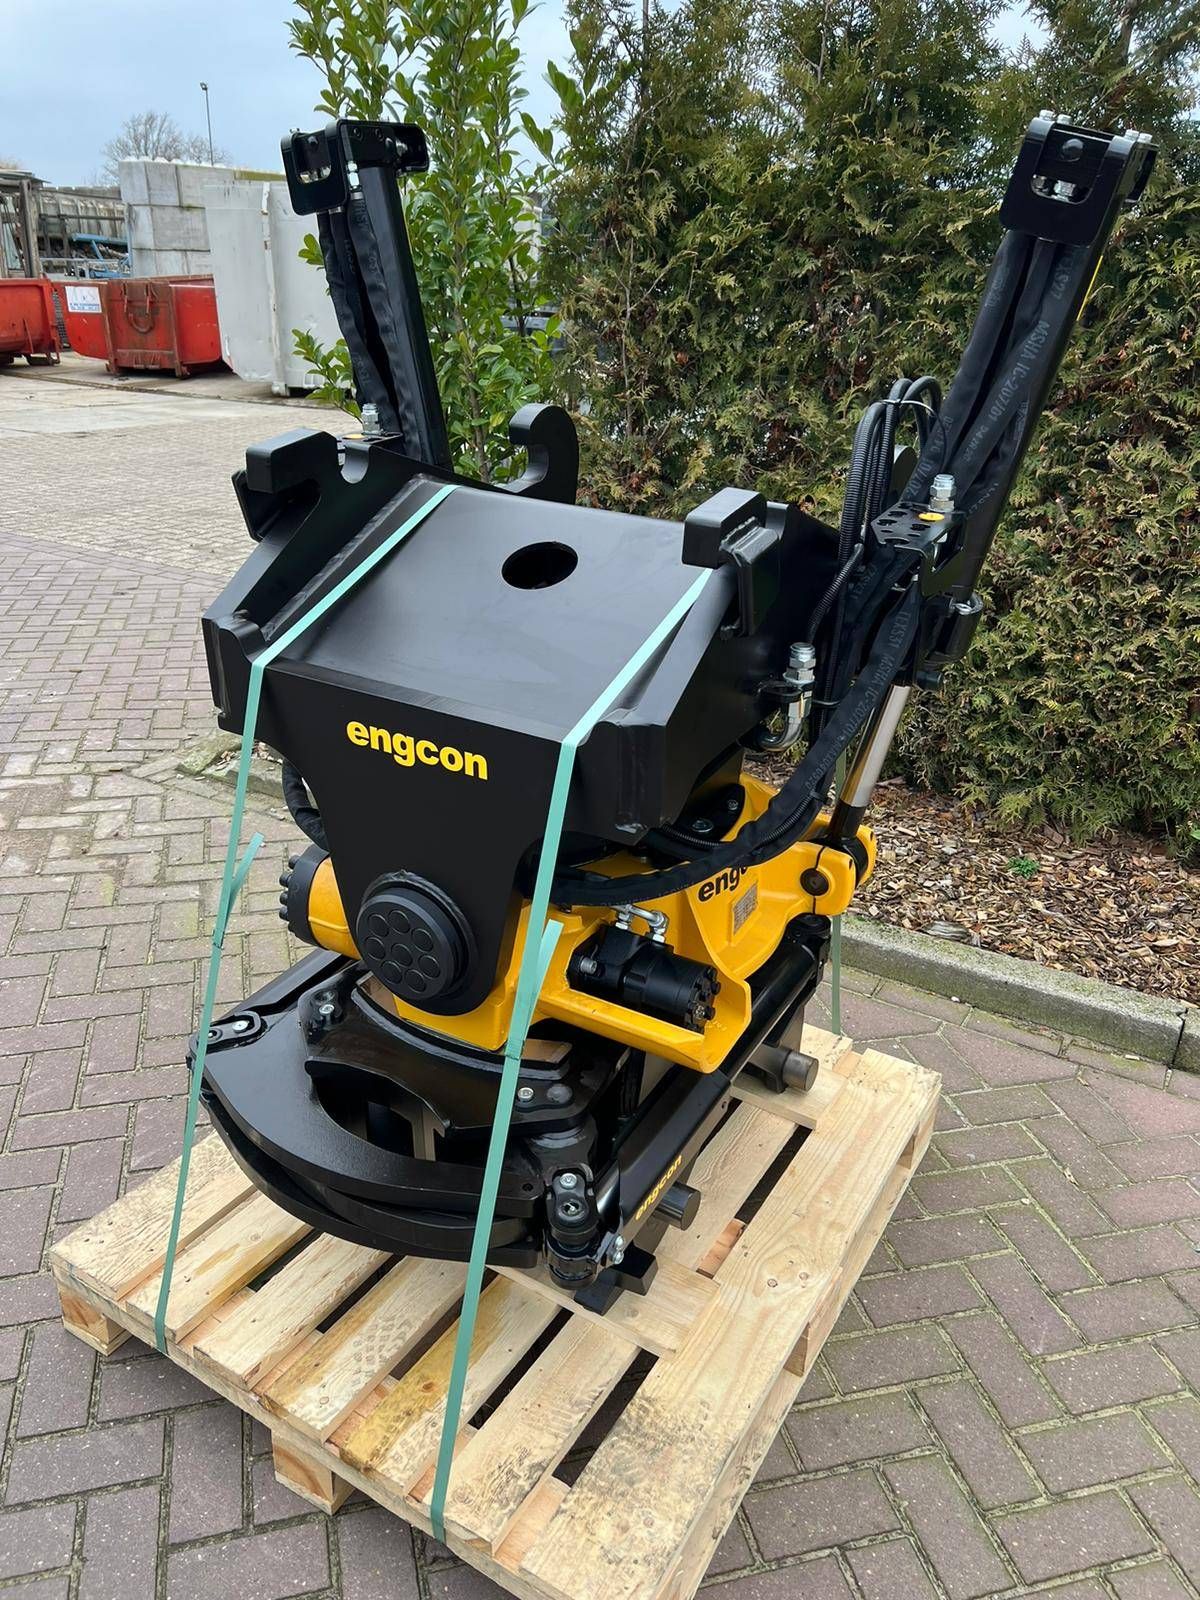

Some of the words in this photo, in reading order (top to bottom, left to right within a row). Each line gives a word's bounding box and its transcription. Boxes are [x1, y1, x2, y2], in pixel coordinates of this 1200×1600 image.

[1020, 321, 1050, 361] MSHA
[347, 720, 489, 781] engcon
[698, 866, 748, 902] eng
[635, 1152, 682, 1220] engcon
